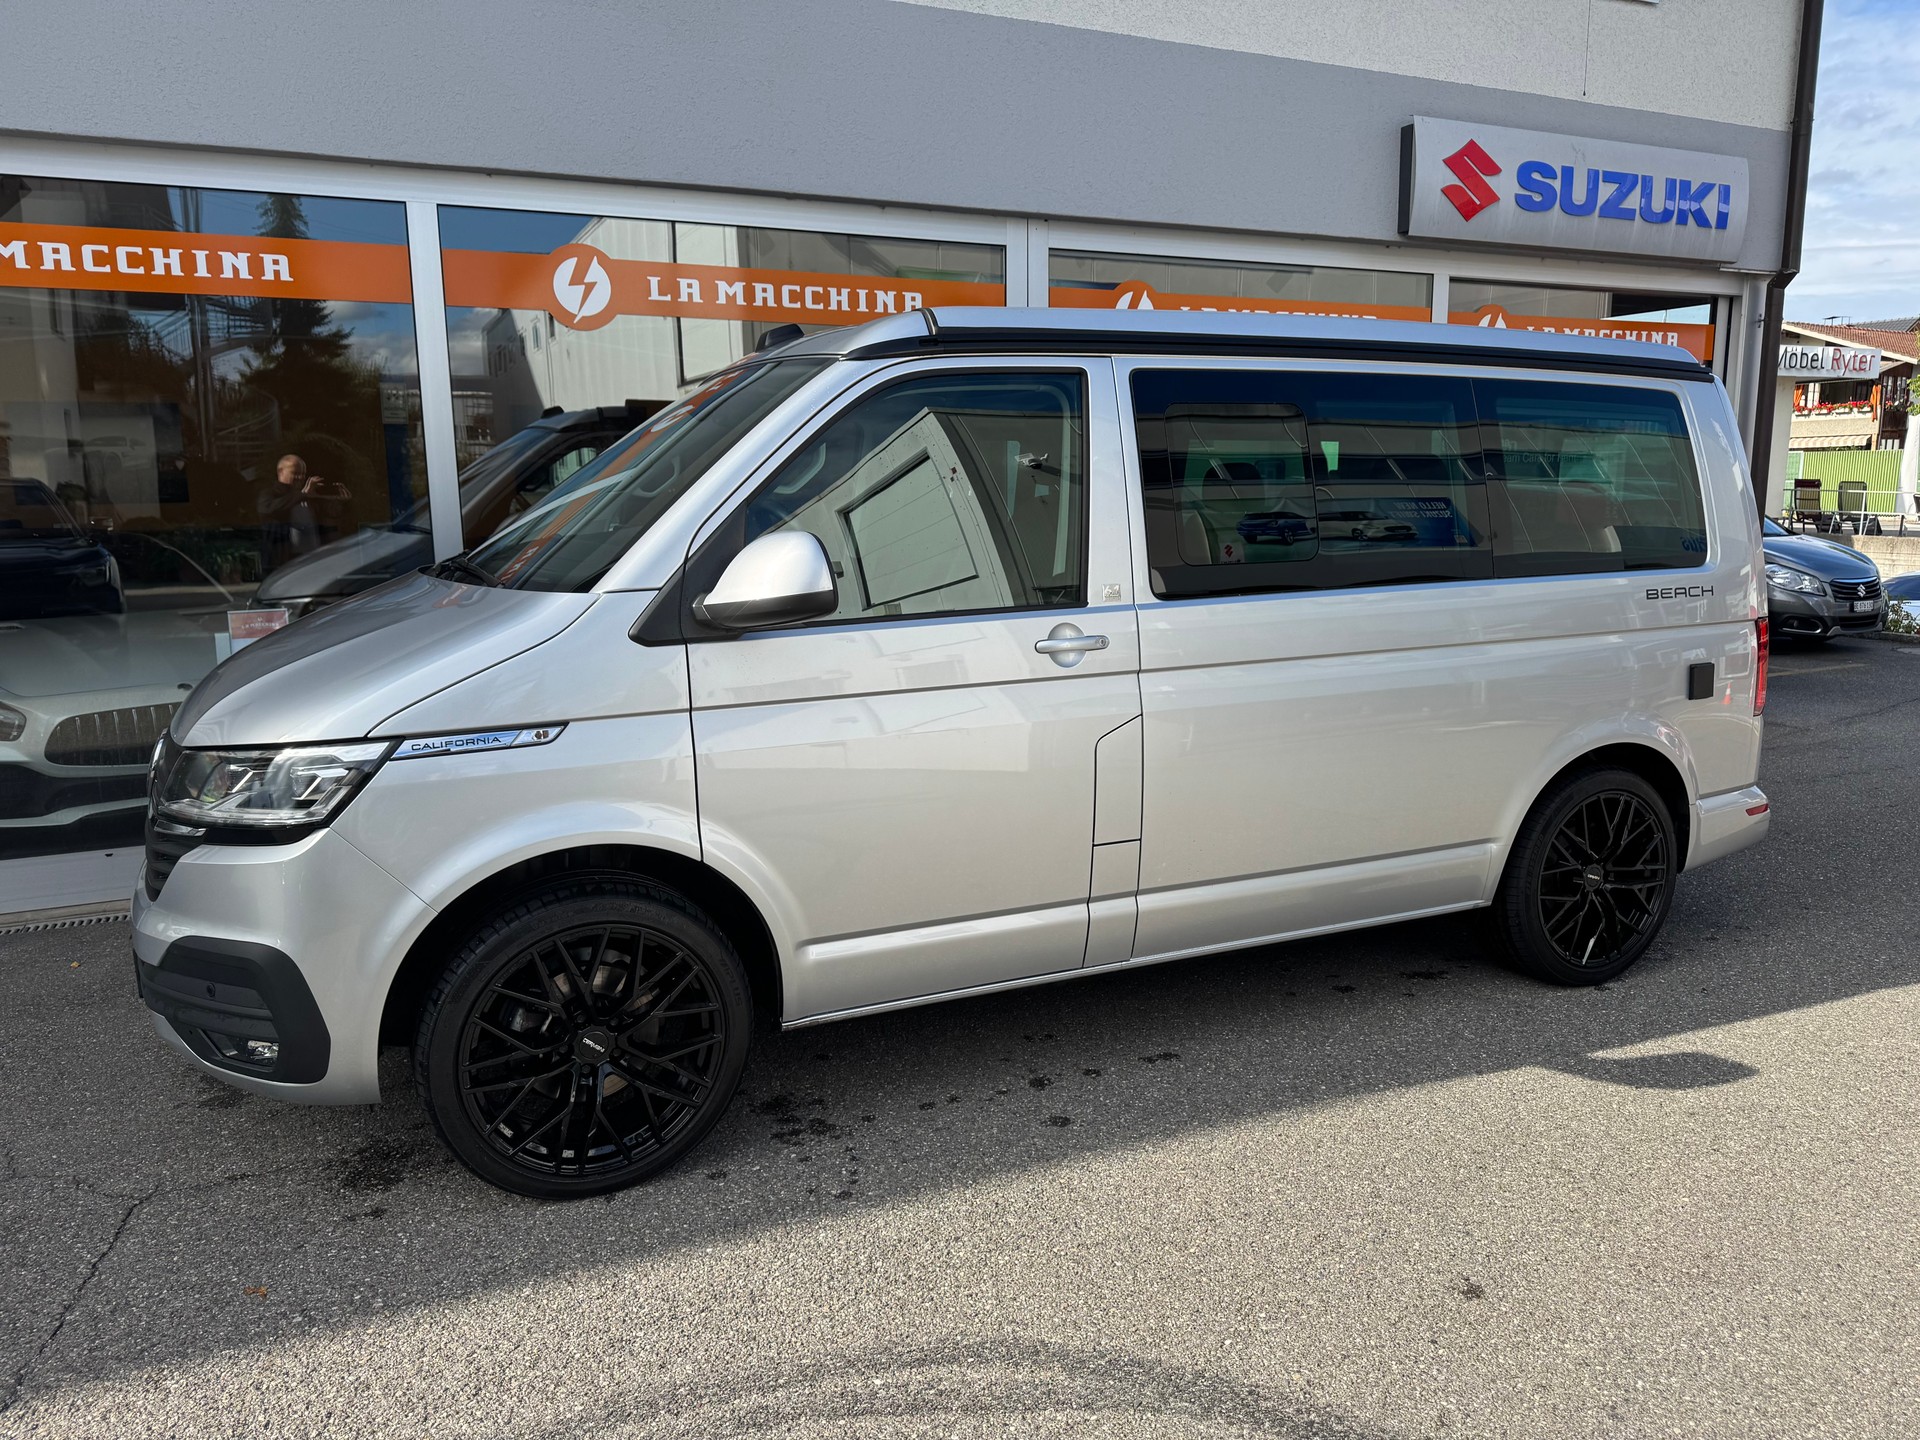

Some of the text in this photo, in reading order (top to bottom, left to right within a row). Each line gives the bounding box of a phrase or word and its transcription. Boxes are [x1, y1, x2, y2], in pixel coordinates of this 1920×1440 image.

[1515, 160, 1731, 230] SUZUKI
[0, 240, 294, 281] MACCHINA
[647, 276, 922, 314] LA MACCHINA
[1831, 348, 1875, 376] Ryter
[1646, 585, 1714, 600] BEACH
[411, 736, 502, 751] CALIFORNIA
